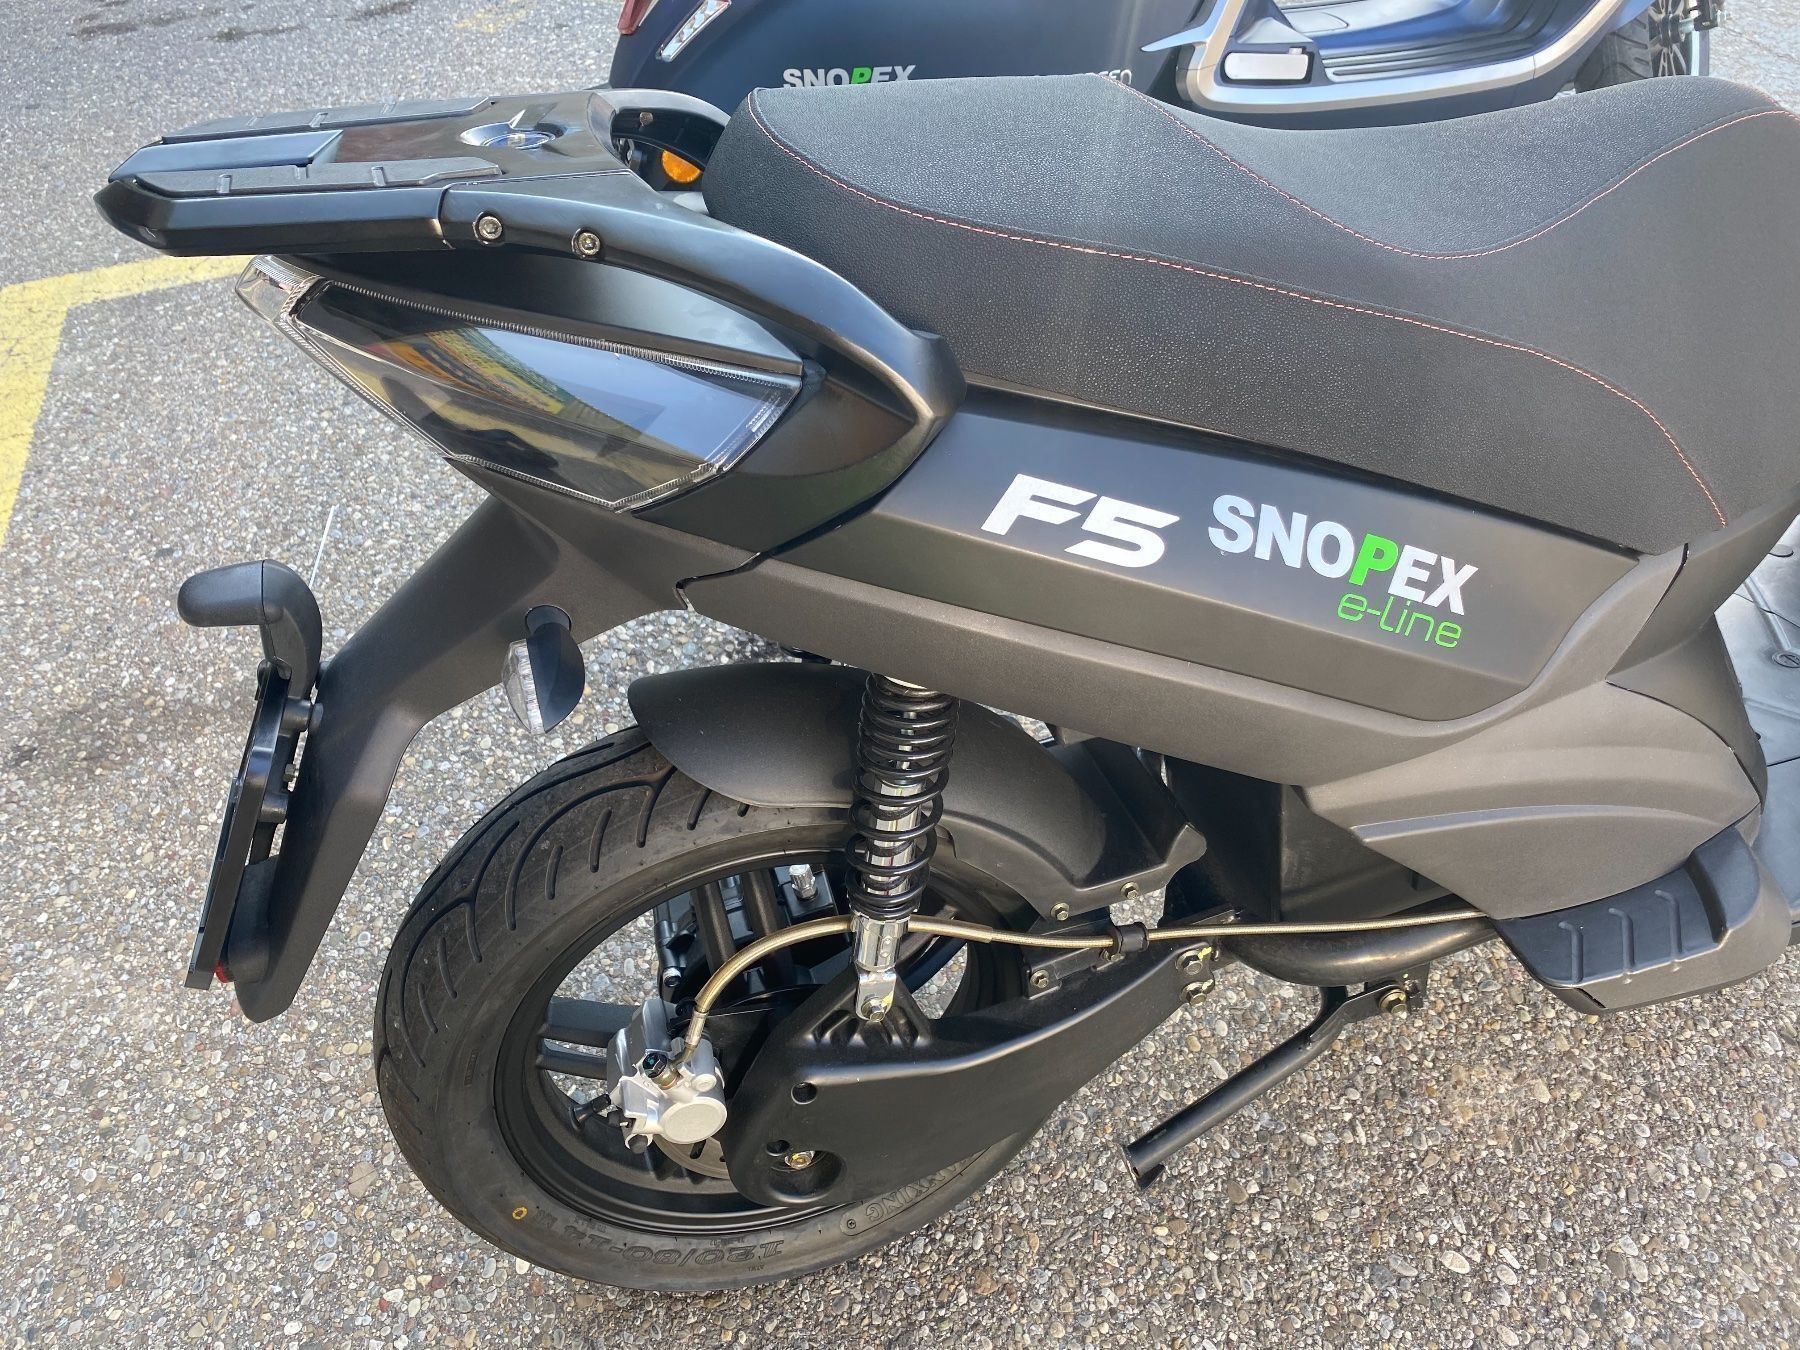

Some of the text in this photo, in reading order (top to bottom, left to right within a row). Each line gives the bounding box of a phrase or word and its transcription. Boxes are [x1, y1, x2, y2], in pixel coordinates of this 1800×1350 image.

[981, 473, 1180, 568] F5
[1208, 494, 1478, 615] SNOPEX
[1337, 591, 1461, 648] e-line
